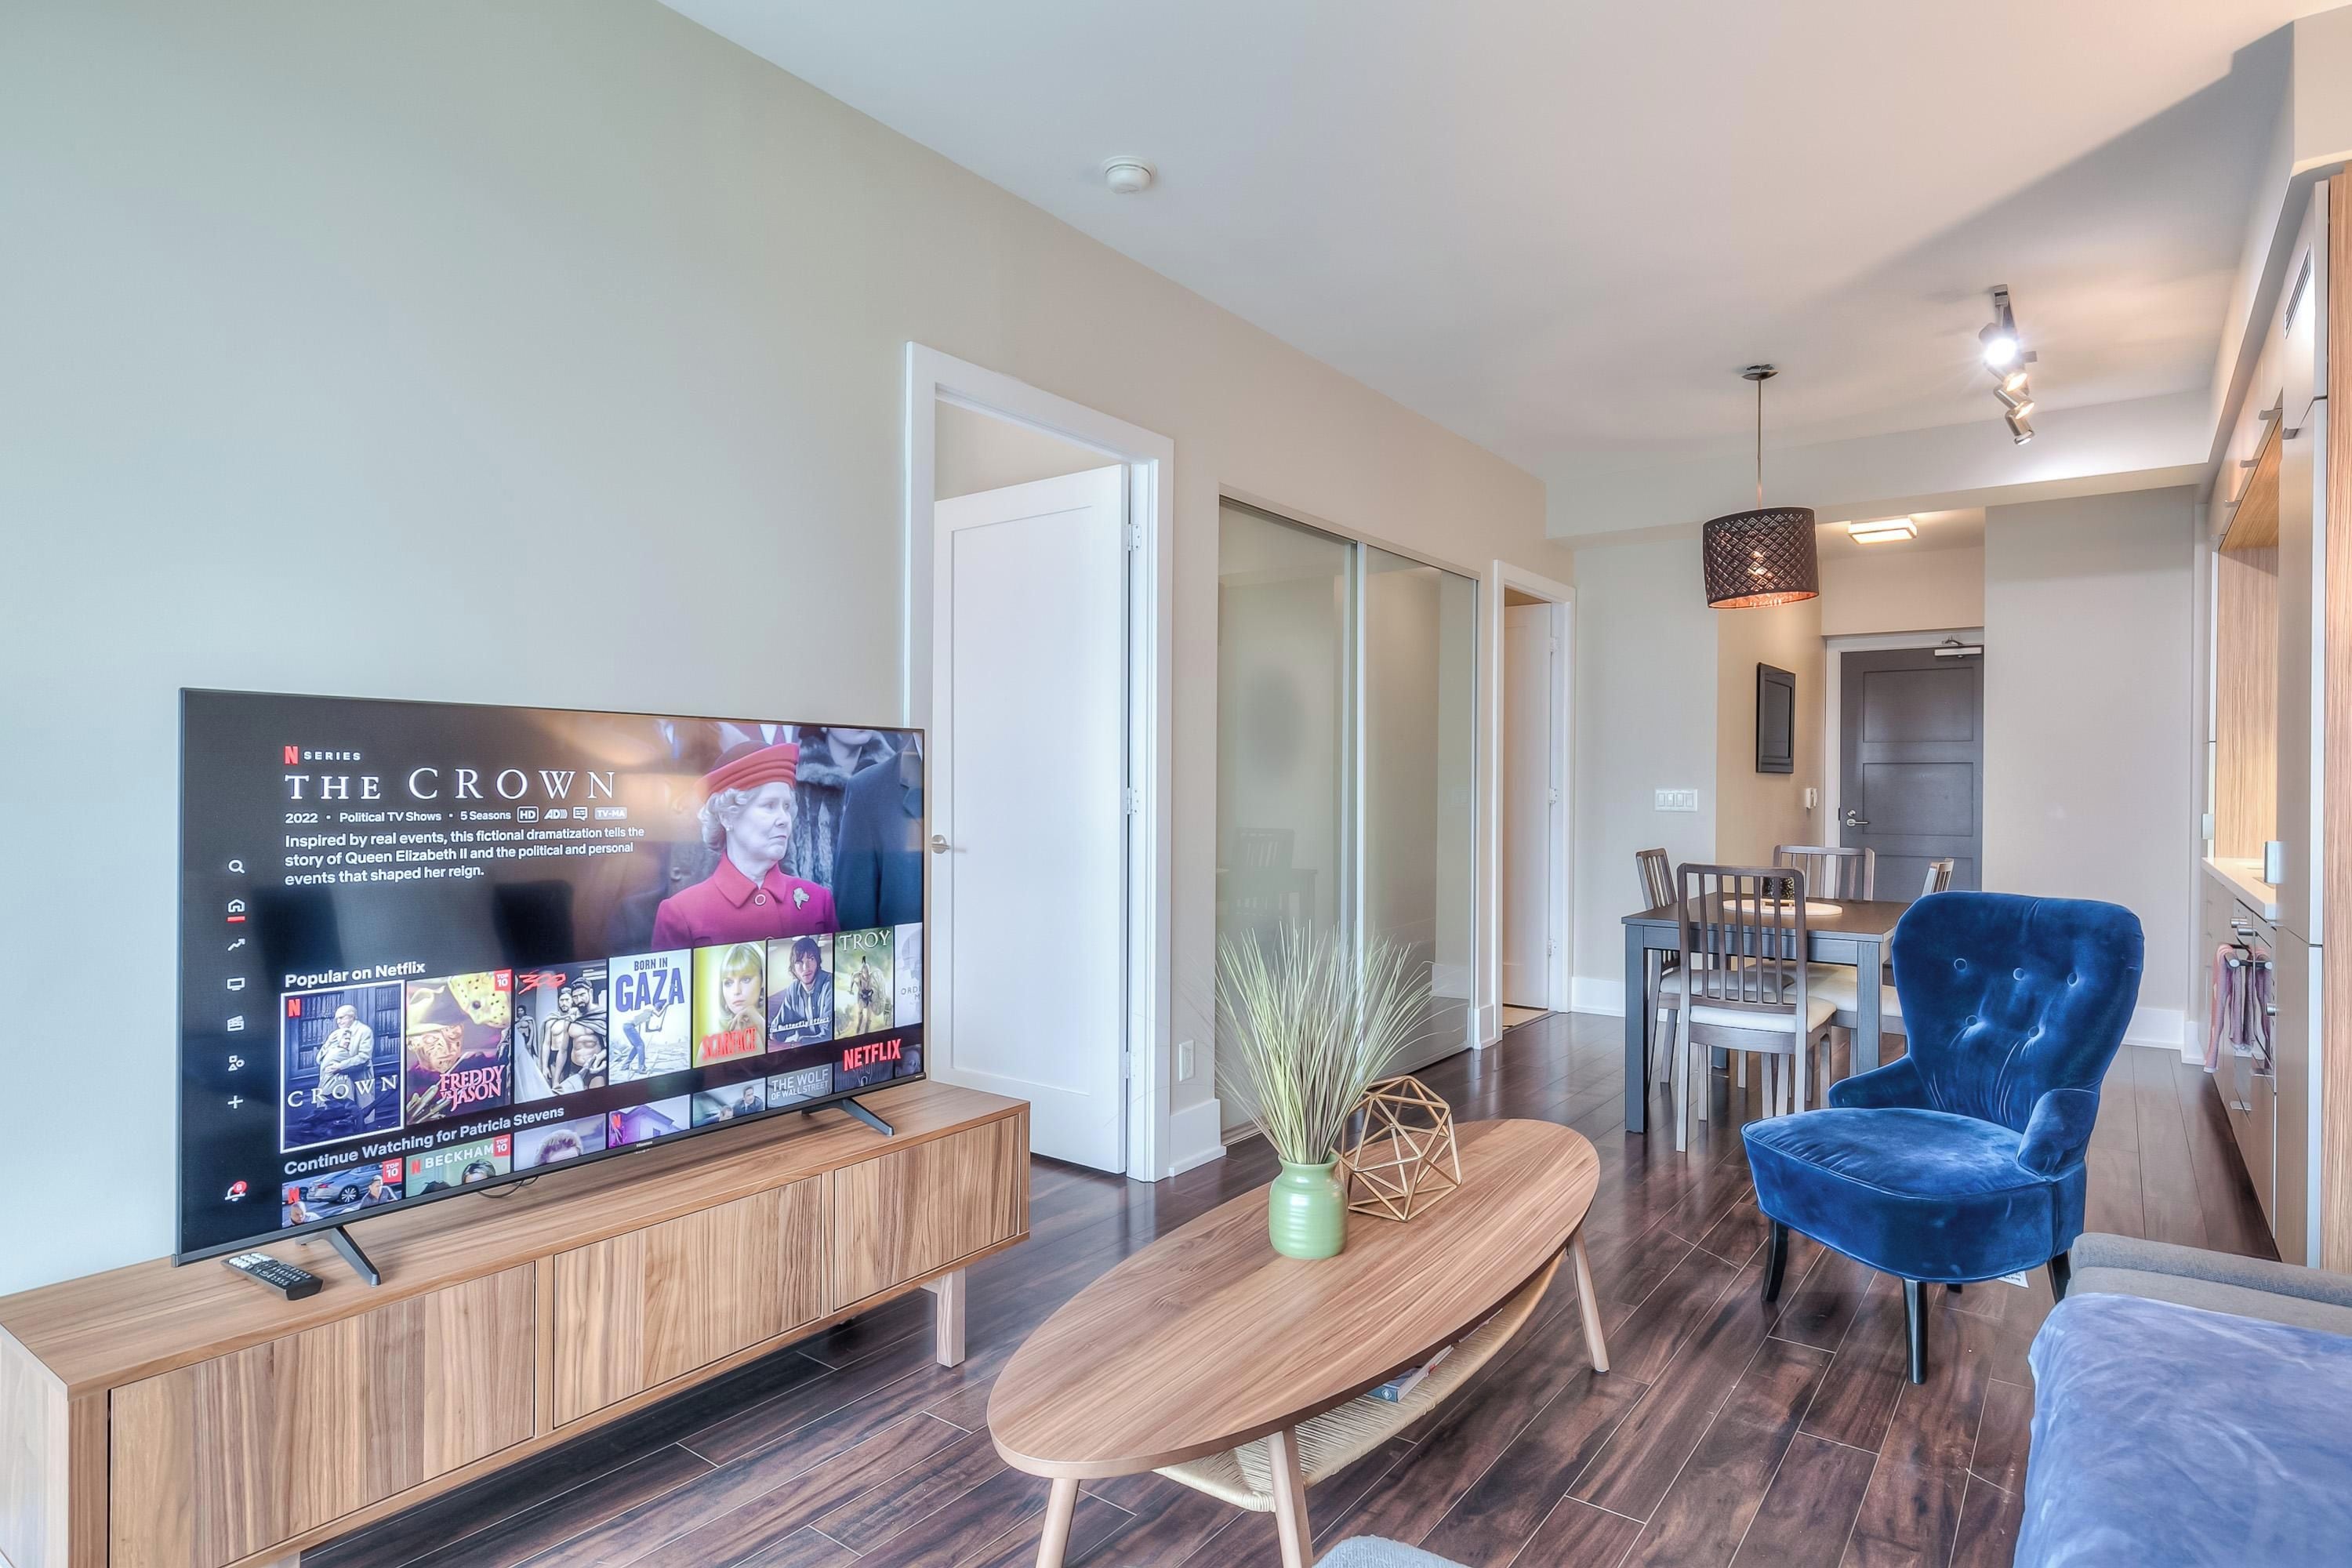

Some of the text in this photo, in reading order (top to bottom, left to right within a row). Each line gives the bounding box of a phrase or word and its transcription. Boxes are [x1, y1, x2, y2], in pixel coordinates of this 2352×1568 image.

[284, 746, 361, 765] N SERIES
[285, 767, 615, 800] THE CROWN
[285, 813, 318, 823] 2022
[339, 811, 385, 822] Political
[387, 811, 404, 822] TV
[406, 811, 441, 822] Shows
[460, 811, 468, 821] 5
[469, 811, 511, 821] Seasons
[519, 810, 536, 819] HD
[285, 826, 644, 849] Inspired by real events, this fictional dramatization tells the
[285, 842, 633, 869] story of Queen Elizabeth II and the political and personal
[285, 865, 485, 886] events that shaped her reign.
[839, 930, 891, 952] TROY
[285, 961, 426, 989] Popular on Netflix
[633, 957, 668, 971] BORN IN
[495, 972, 510, 981] TOP
[498, 978, 509, 988] 10
[518, 970, 566, 995] 300
[615, 967, 684, 1013] GAZA
[288, 998, 301, 1018] N
[702, 1025, 757, 1061] SCARFACE
[844, 1039, 901, 1072] NETFLIX
[440, 1065, 505, 1091] FREDDY
[771, 1069, 829, 1092] THE WOLF
[287, 1075, 398, 1109] CROWN
[451, 1079, 503, 1112] JASON
[771, 1080, 829, 1101] OF WALL STREET
[284, 1106, 564, 1175] Continue Watching for Patricia Stevens
[495, 1138, 509, 1146] TOP
[496, 1142, 508, 1152] 10
[385, 1162, 400, 1171] TOP
[424, 1143, 494, 1170] BECKHAM
[387, 1168, 399, 1178] 10
